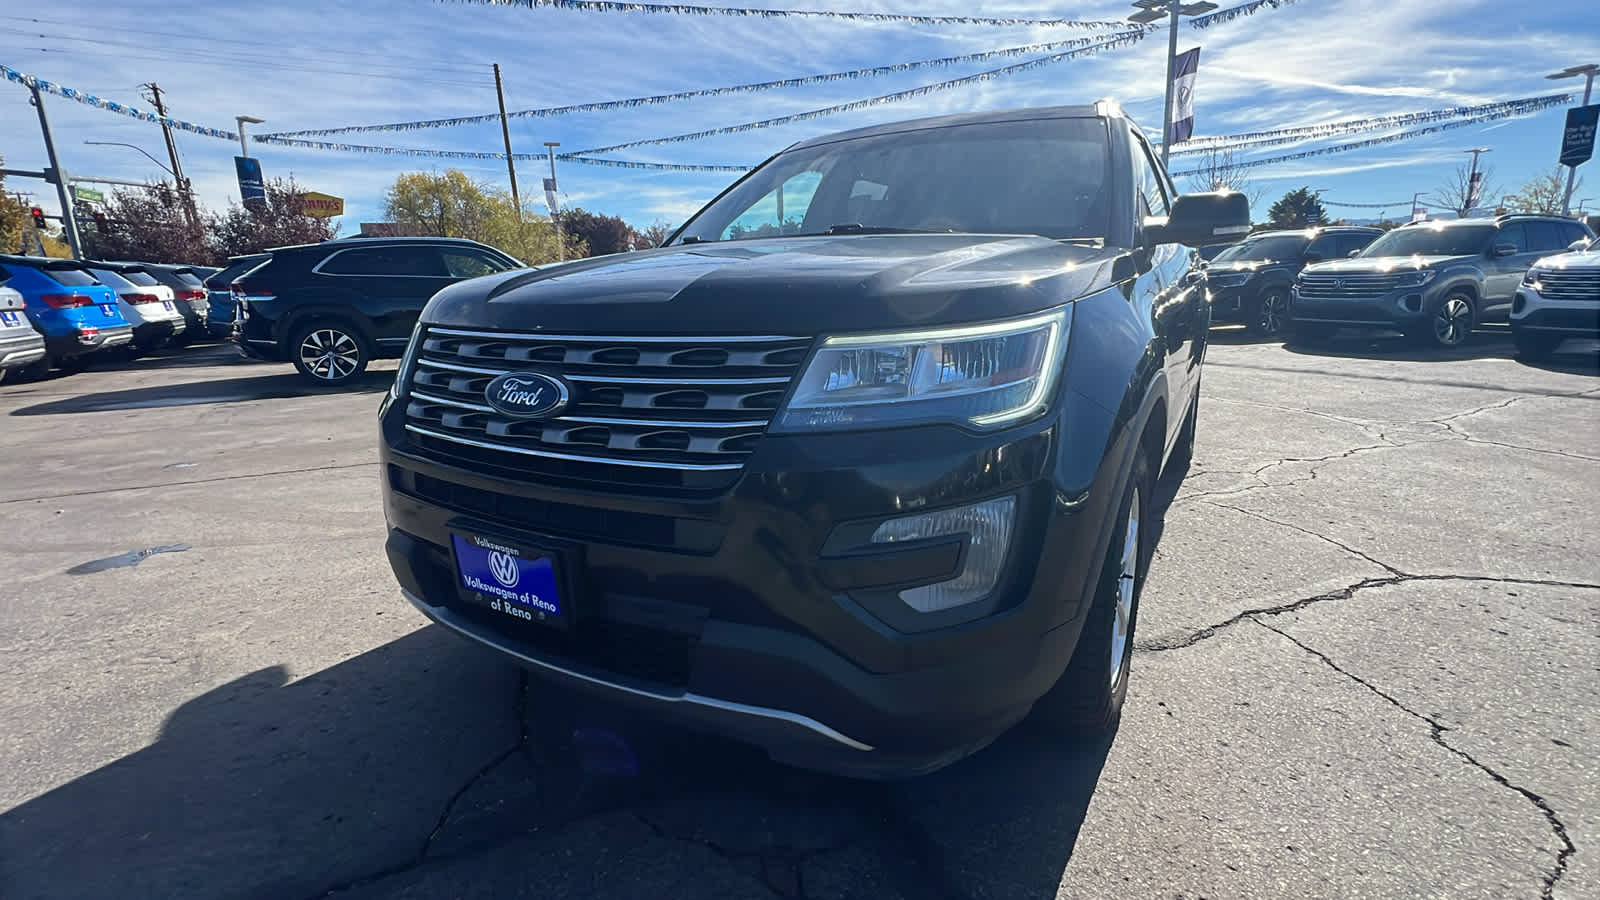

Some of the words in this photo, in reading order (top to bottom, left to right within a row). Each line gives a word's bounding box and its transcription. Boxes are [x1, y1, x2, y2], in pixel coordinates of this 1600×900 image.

[497, 378, 543, 406] Ford
[474, 536, 520, 556] Volkswagen
[464, 575, 518, 600] Volkswagen
[520, 592, 530, 604] of
[532, 594, 556, 612] Reno
[491, 599, 501, 611] of
[504, 601, 531, 620] Reno
